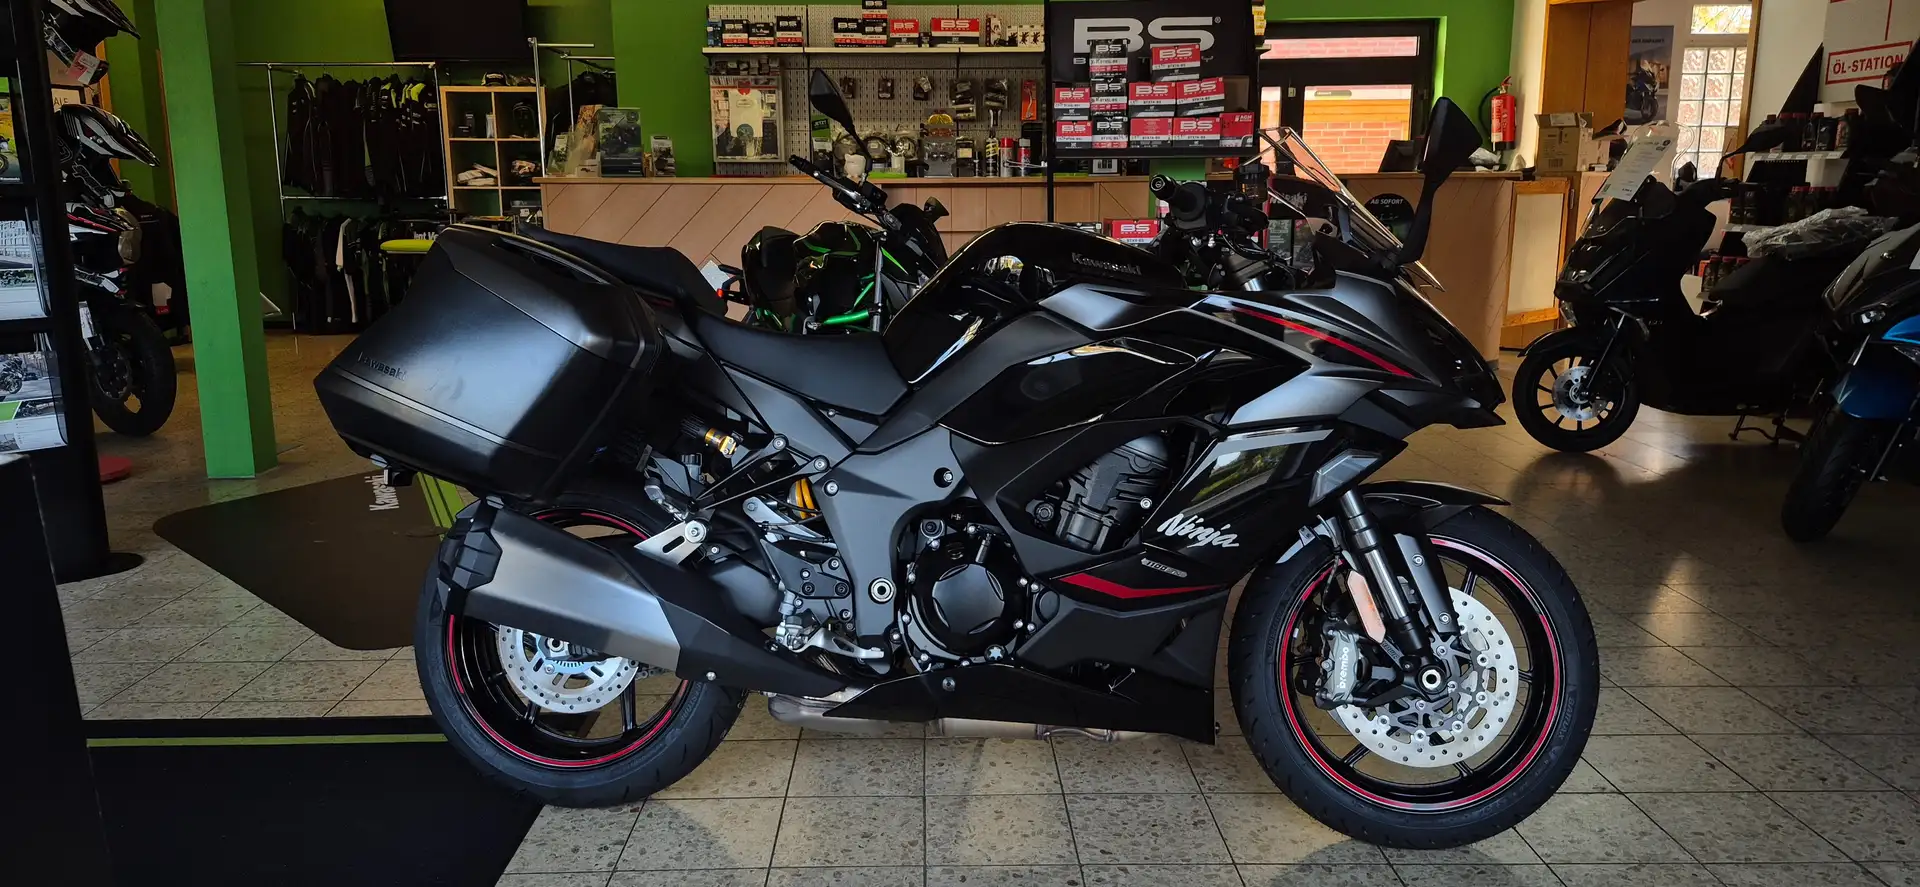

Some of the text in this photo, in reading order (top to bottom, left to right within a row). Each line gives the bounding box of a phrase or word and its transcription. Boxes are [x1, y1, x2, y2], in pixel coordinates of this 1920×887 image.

[940, 20, 970, 28] BS
[1159, 48, 1192, 58] BS
[1833, 54, 1904, 75] ÖL-STATION
[1135, 85, 1168, 94] BS
[1183, 81, 1216, 93] BS
[1097, 121, 1123, 129] BS
[1180, 121, 1213, 129] BS
[1120, 224, 1151, 232] BS
[1071, 251, 1142, 275] Kawasaki
[358, 351, 408, 381] Kawasaki
[1156, 513, 1240, 548] Ninja
[1336, 646, 1350, 689] brembo
